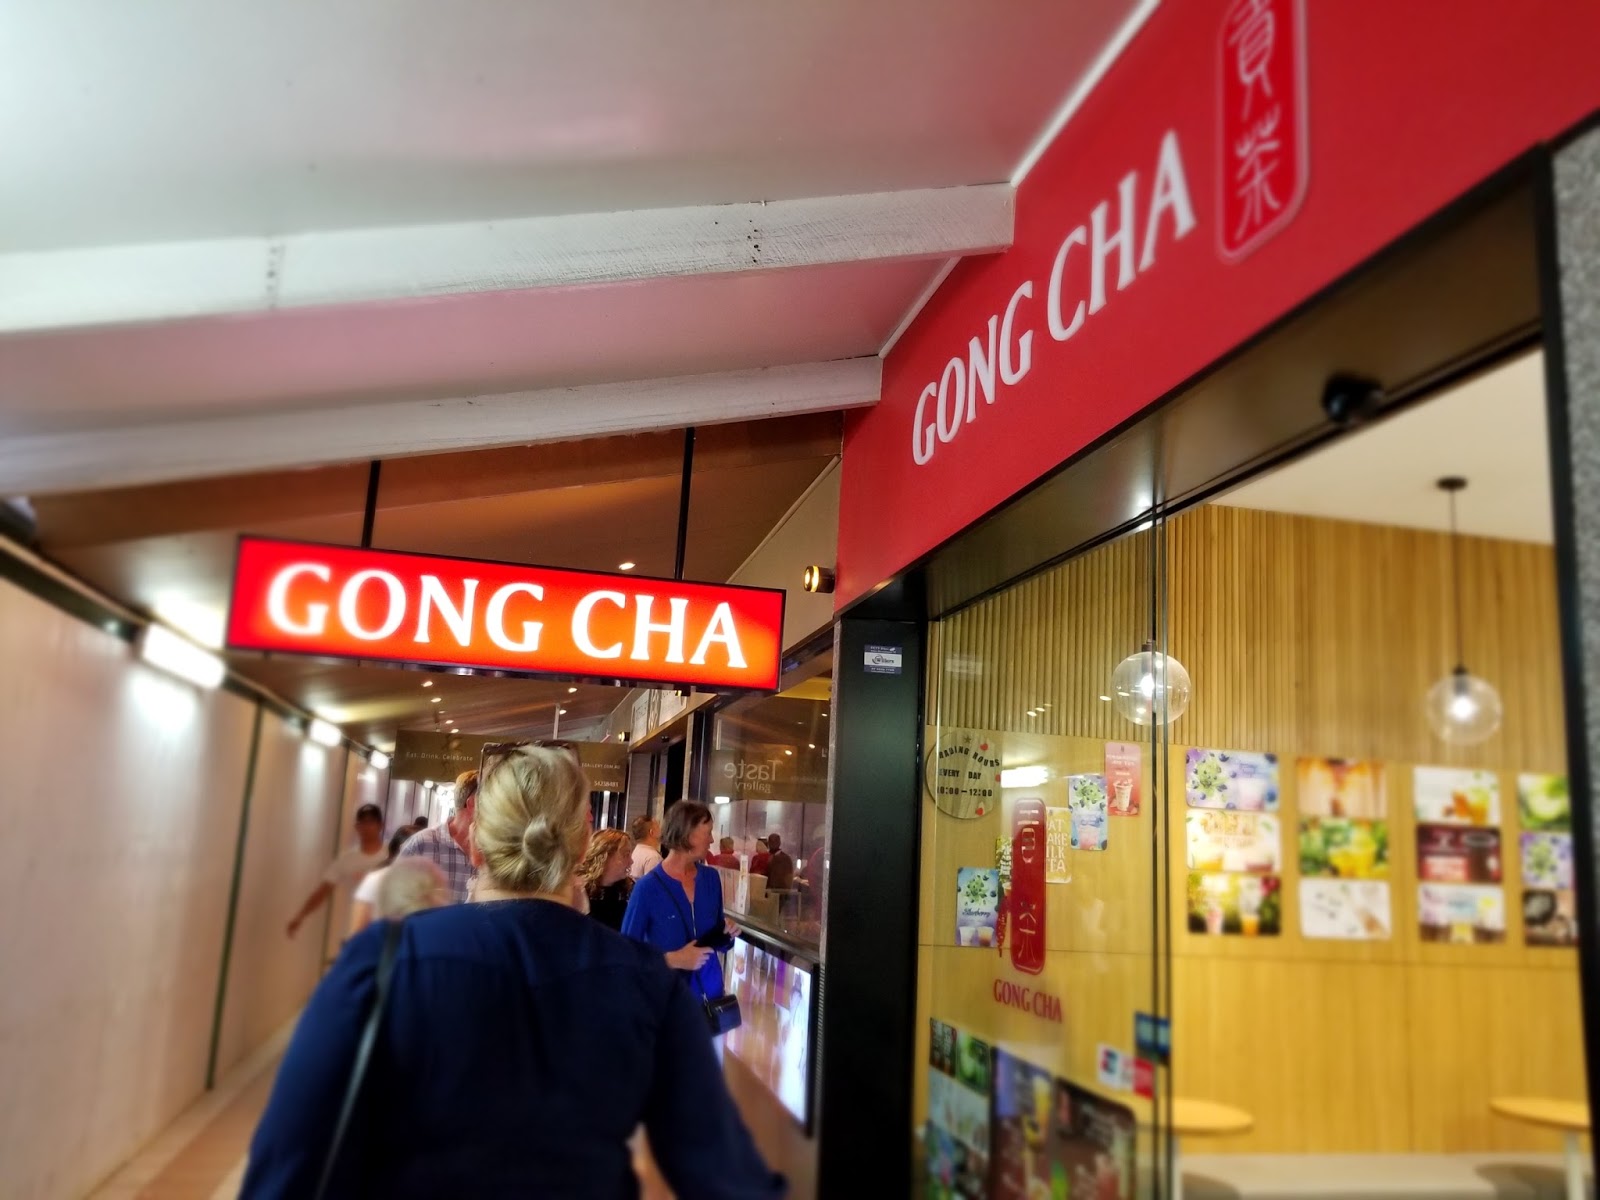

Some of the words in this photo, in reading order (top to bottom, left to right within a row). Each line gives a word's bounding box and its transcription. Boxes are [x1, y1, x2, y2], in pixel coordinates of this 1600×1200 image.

[912, 280, 1033, 466] GONG
[1047, 129, 1196, 341] CHA
[266, 562, 546, 653] GONG
[571, 589, 748, 669] CHA
[442, 753, 474, 762] Celebrate
[936, 746, 970, 759] RADING
[972, 751, 1000, 768] HOURS
[938, 768, 960, 778] EVERY
[968, 771, 982, 780] DAY
[1047, 818, 1065, 832] AT
[1046, 832, 1068, 847] AKE
[1045, 845, 1065, 860] ILK
[993, 978, 1030, 1013] GONG
[1032, 990, 1062, 1024] CHA
